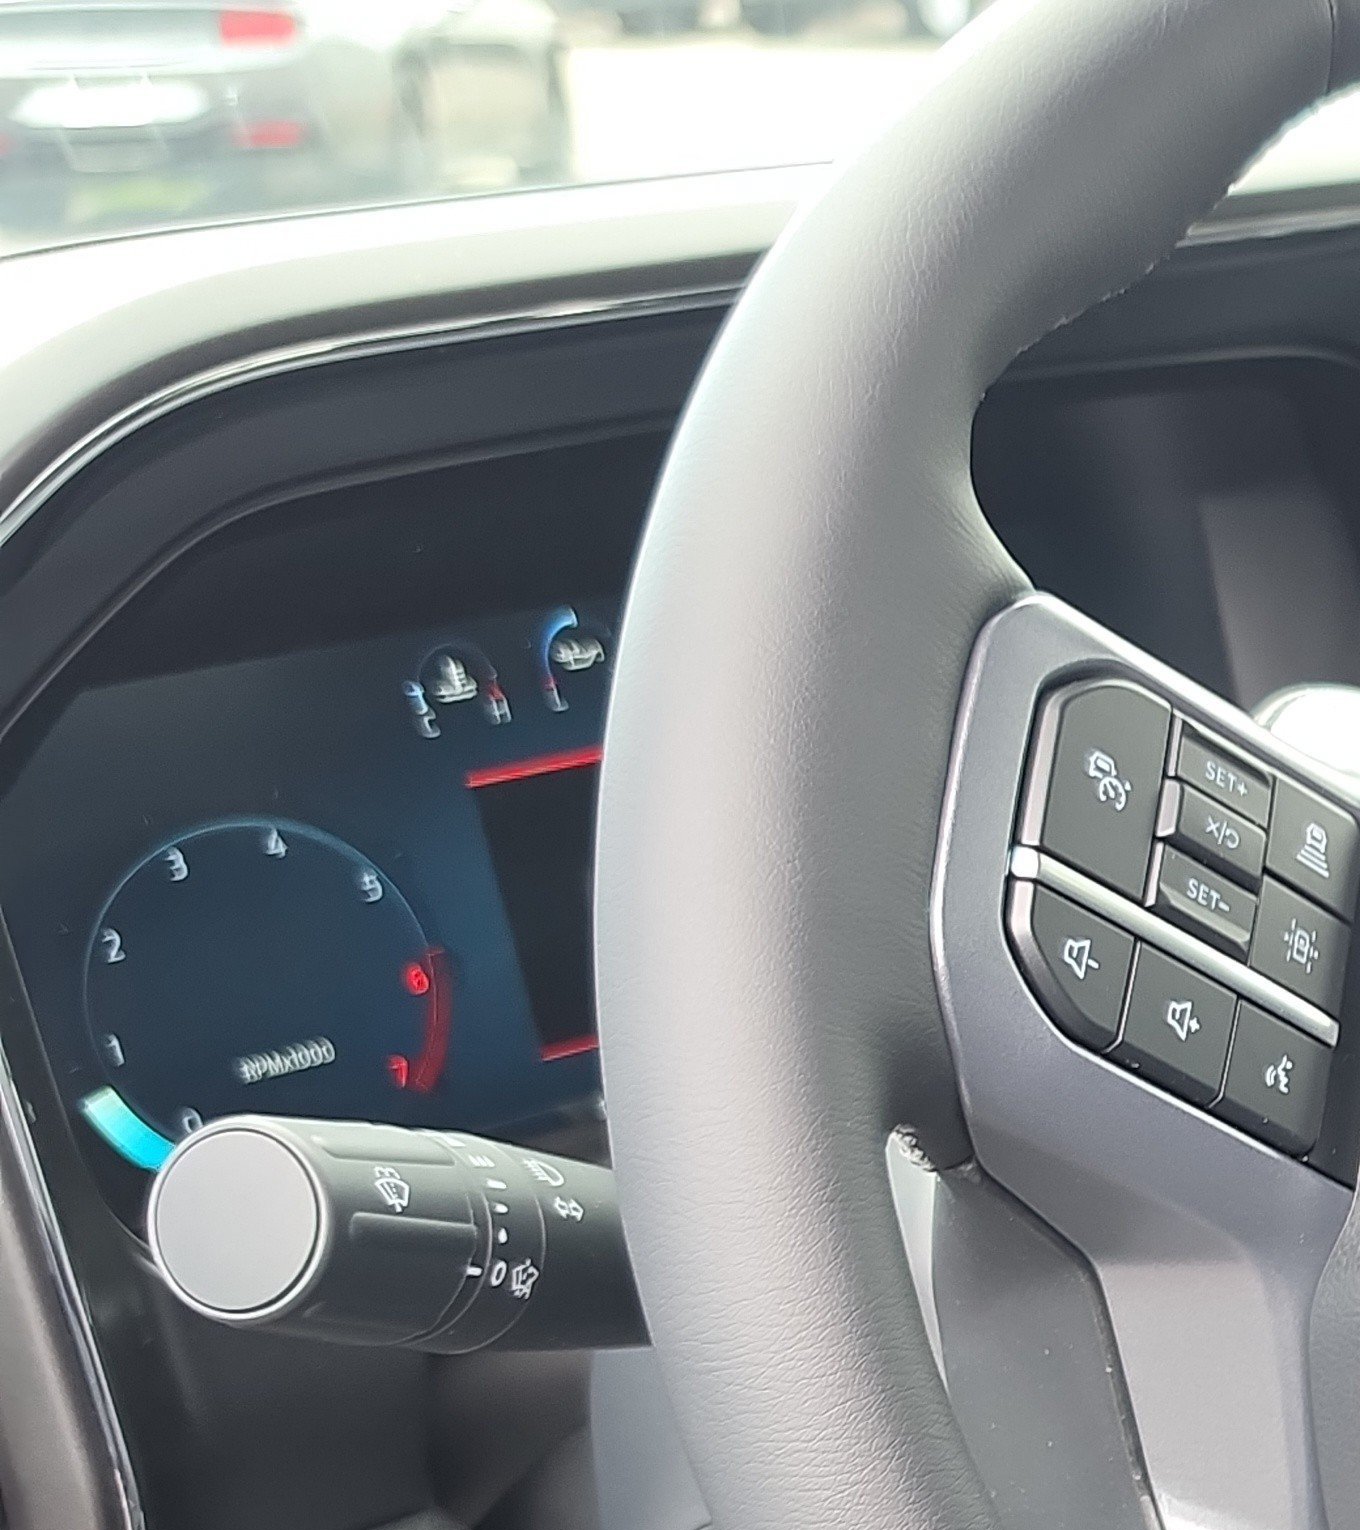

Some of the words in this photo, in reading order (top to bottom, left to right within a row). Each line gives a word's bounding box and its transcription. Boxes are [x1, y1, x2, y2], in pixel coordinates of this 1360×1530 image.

[1205, 760, 1248, 796] SET+
[264, 828, 288, 859] 4
[163, 846, 189, 882] 3
[1186, 876, 1230, 914] SET-
[101, 927, 126, 963] 2
